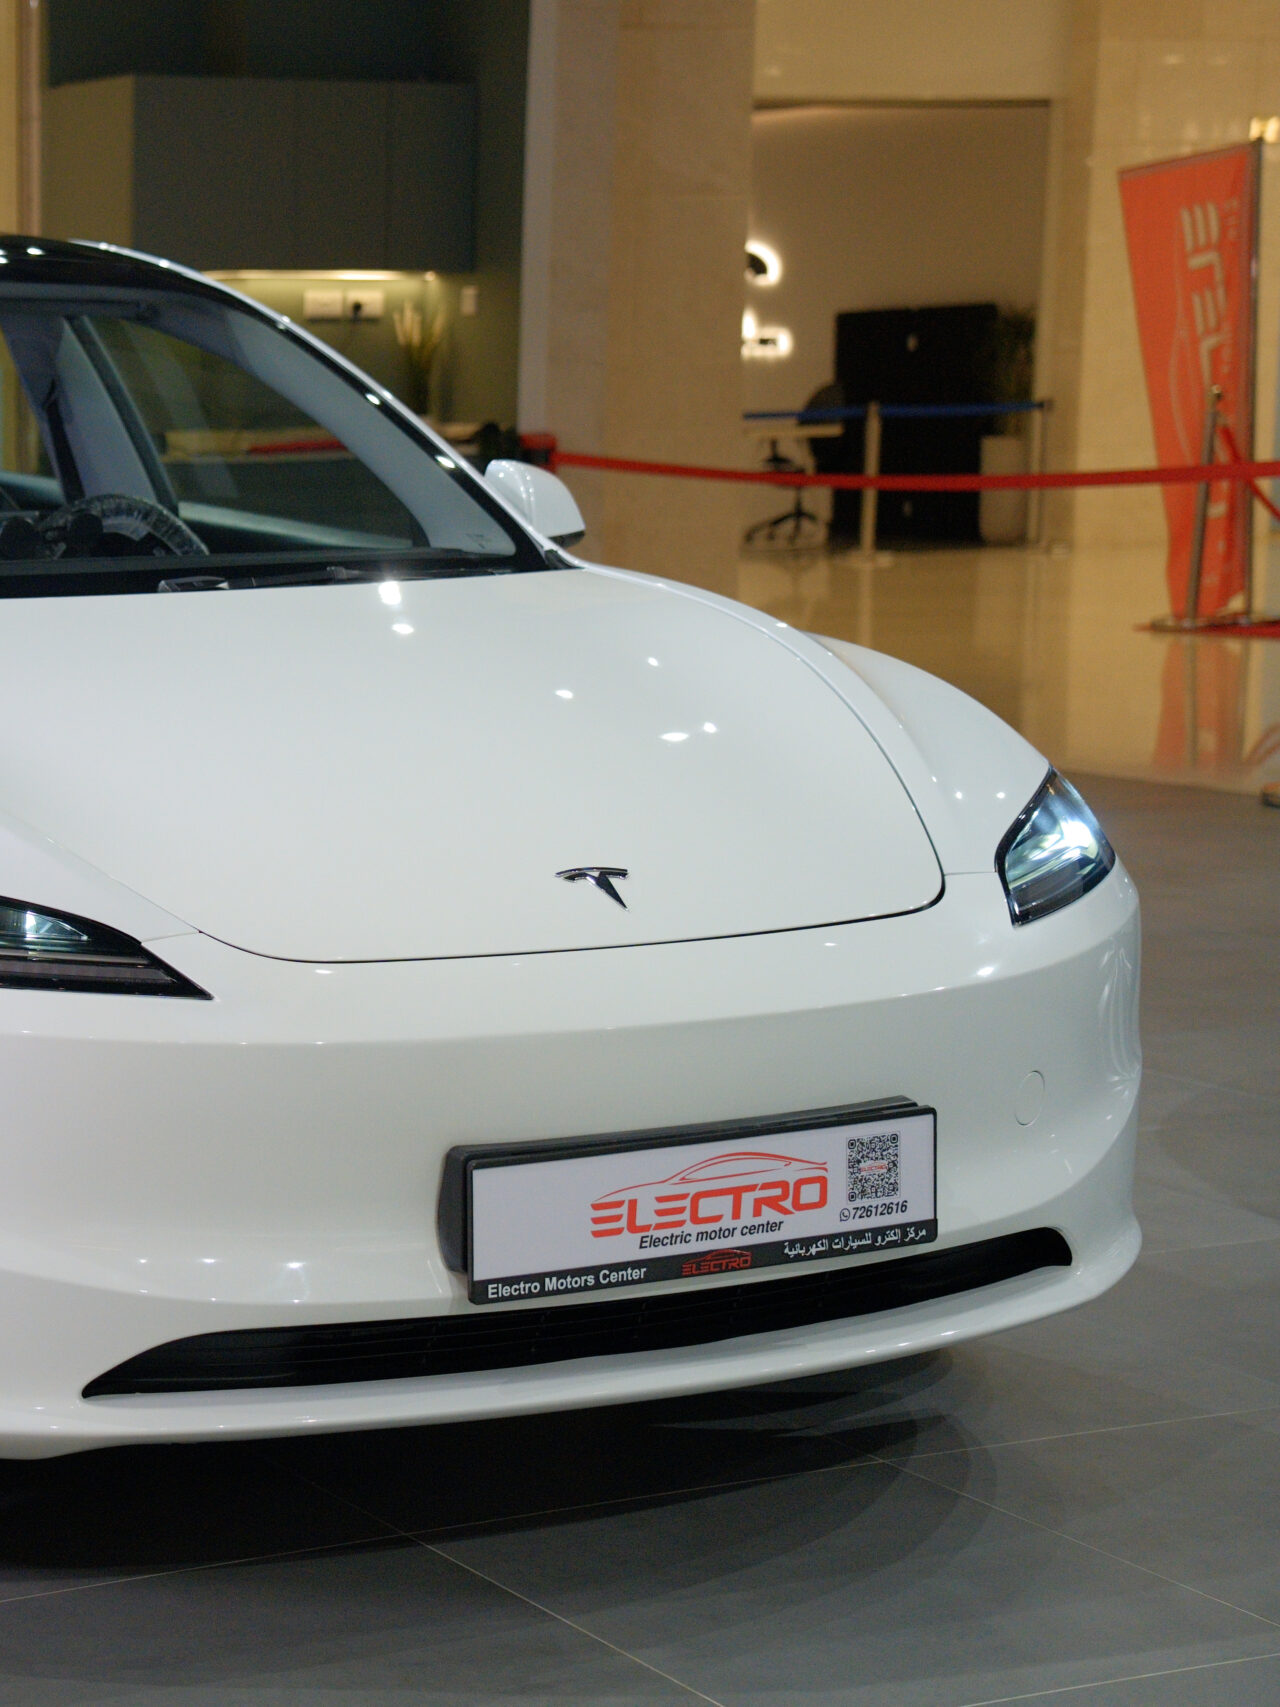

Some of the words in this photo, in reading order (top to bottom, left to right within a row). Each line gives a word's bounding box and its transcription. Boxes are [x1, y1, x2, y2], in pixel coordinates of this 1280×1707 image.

[590, 1175, 828, 1238] ELECTRO
[852, 1200, 908, 1219] 72612616
[639, 1231, 692, 1249] Electric
[696, 1227, 737, 1242] motor
[740, 1220, 783, 1236] center
[832, 1232, 872, 1250] للسيارات
[904, 1227, 926, 1241] مركز
[682, 1256, 751, 1276] ELECTRO
[487, 1281, 540, 1299] Electro
[544, 1273, 595, 1292] Motors
[599, 1266, 646, 1284] Center
